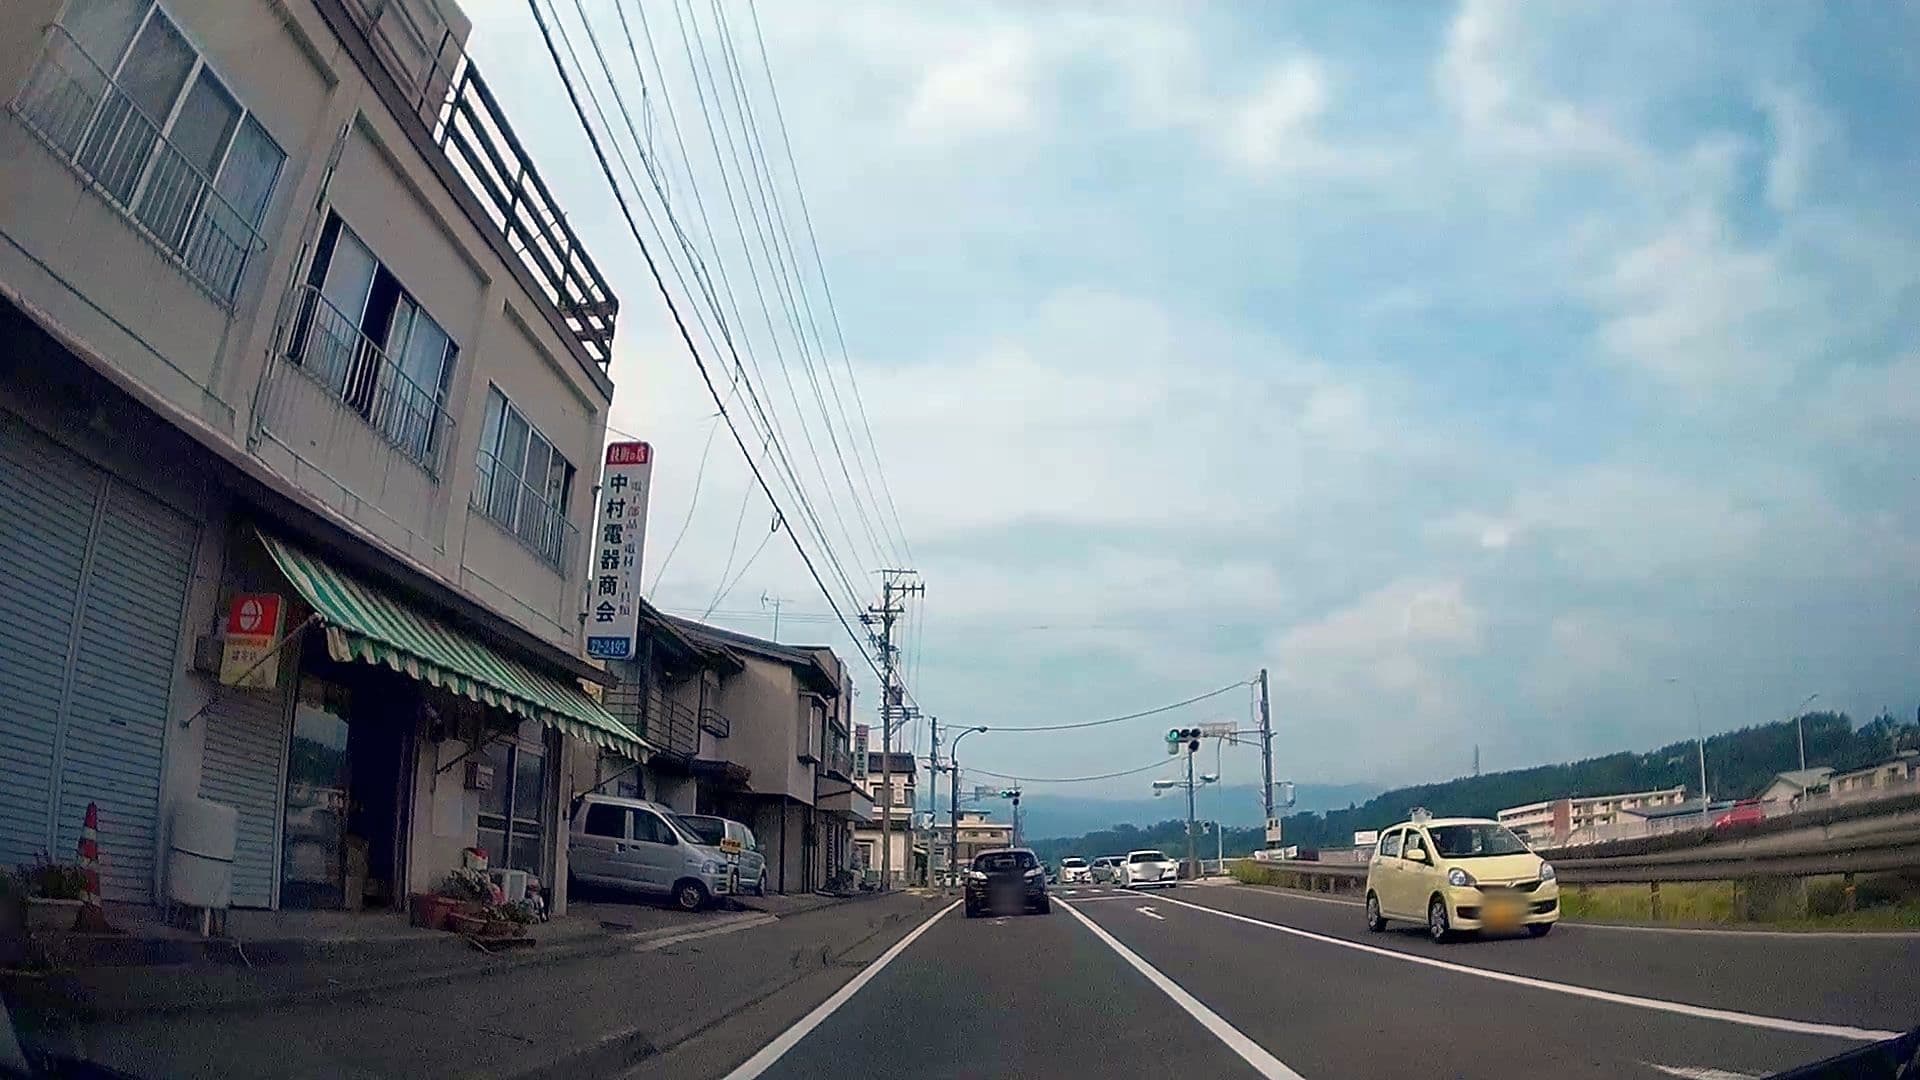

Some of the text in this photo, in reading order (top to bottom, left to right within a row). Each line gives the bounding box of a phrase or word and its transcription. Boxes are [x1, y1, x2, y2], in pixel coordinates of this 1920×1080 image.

[595, 473, 628, 623] 中村電器商会
